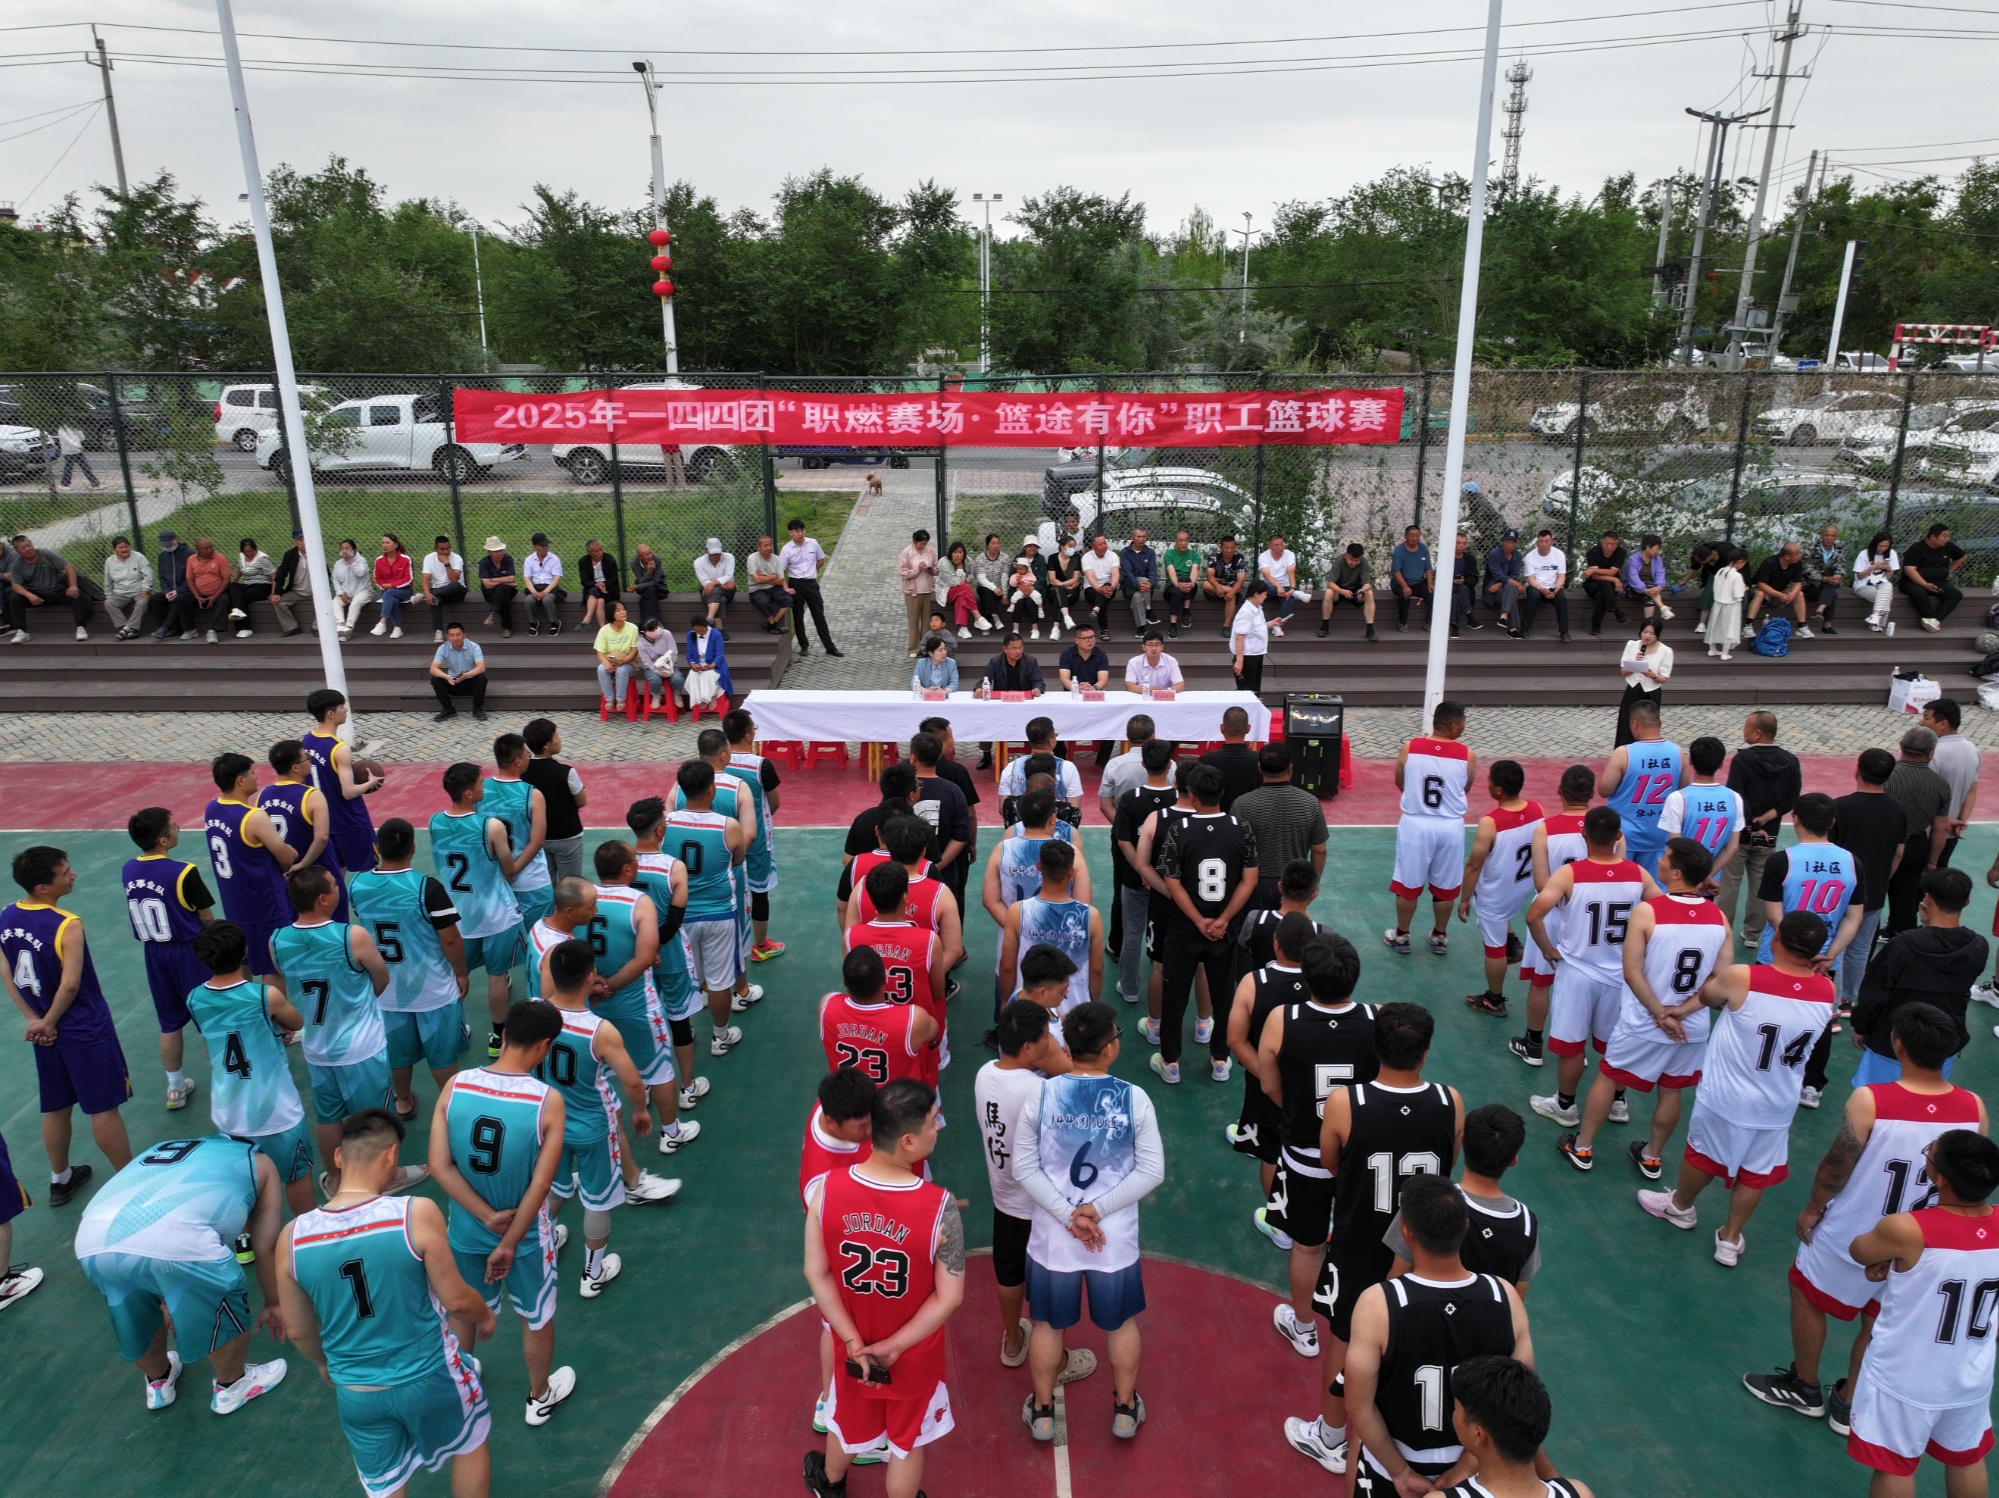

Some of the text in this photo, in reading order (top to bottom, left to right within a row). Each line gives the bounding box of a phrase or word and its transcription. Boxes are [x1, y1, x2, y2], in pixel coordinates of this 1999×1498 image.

[1423, 774, 1445, 809] 6
[1631, 773, 1673, 804] 12
[1694, 817, 1729, 848] 11
[211, 835, 233, 879] 3
[446, 851, 474, 893] 2
[680, 839, 704, 876] 0
[1515, 843, 1532, 883] 2
[1198, 858, 1226, 902] 8
[1796, 879, 1846, 915] 10
[128, 898, 172, 942] 10
[588, 914, 608, 958] 6
[1586, 901, 1634, 946] 15
[373, 921, 405, 964] 5
[14, 950, 41, 997] 4
[1671, 948, 1704, 994] 8
[300, 979, 331, 1026] 7
[223, 1031, 252, 1079] 4
[837, 1024, 887, 1045] JORDAN
[1756, 1023, 1815, 1072] 14
[836, 1041, 889, 1084] 23
[1315, 1063, 1354, 1120] 5
[139, 1139, 205, 1167] 9
[469, 1114, 506, 1176] 9
[1070, 1141, 1099, 1190] 6
[843, 1212, 911, 1245] JORDAN
[338, 1258, 375, 1320] 1
[840, 1240, 910, 1298] 23
